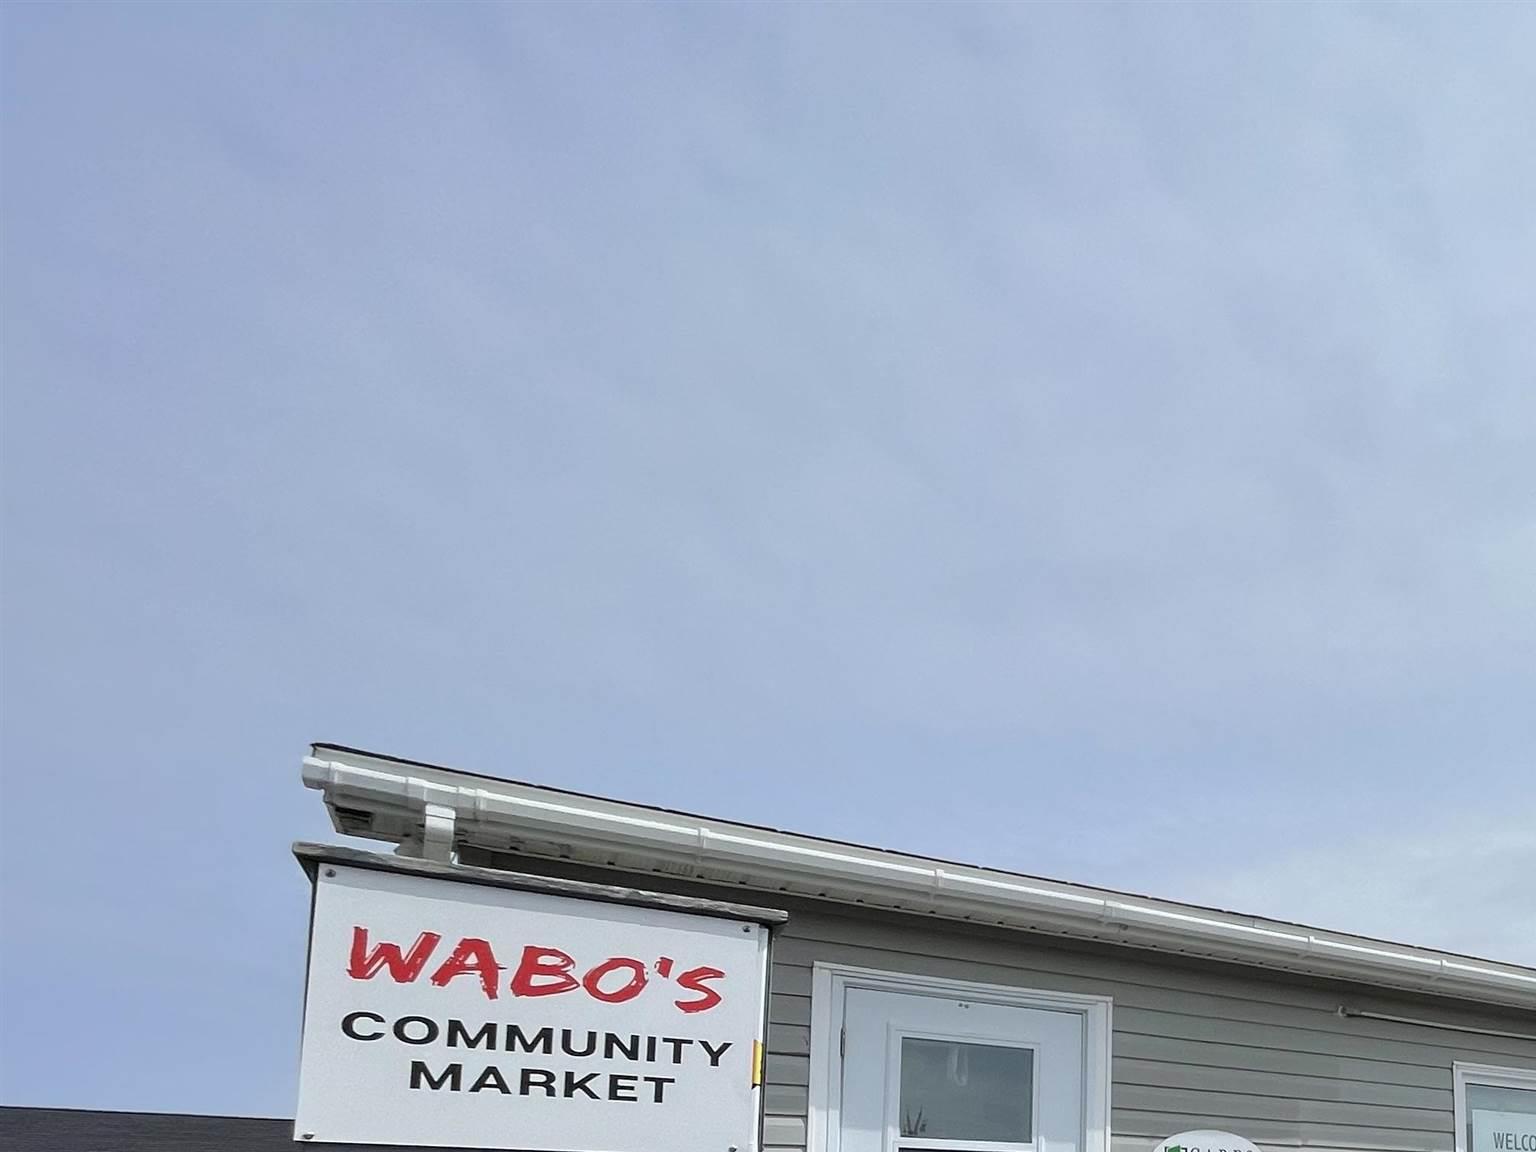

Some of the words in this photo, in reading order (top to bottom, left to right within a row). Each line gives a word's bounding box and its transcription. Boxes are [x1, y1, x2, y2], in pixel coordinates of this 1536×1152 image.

[346, 926, 726, 1014] WABO'S
[341, 1011, 733, 1067] COMMUNITY
[409, 1061, 676, 1104] MARKET
